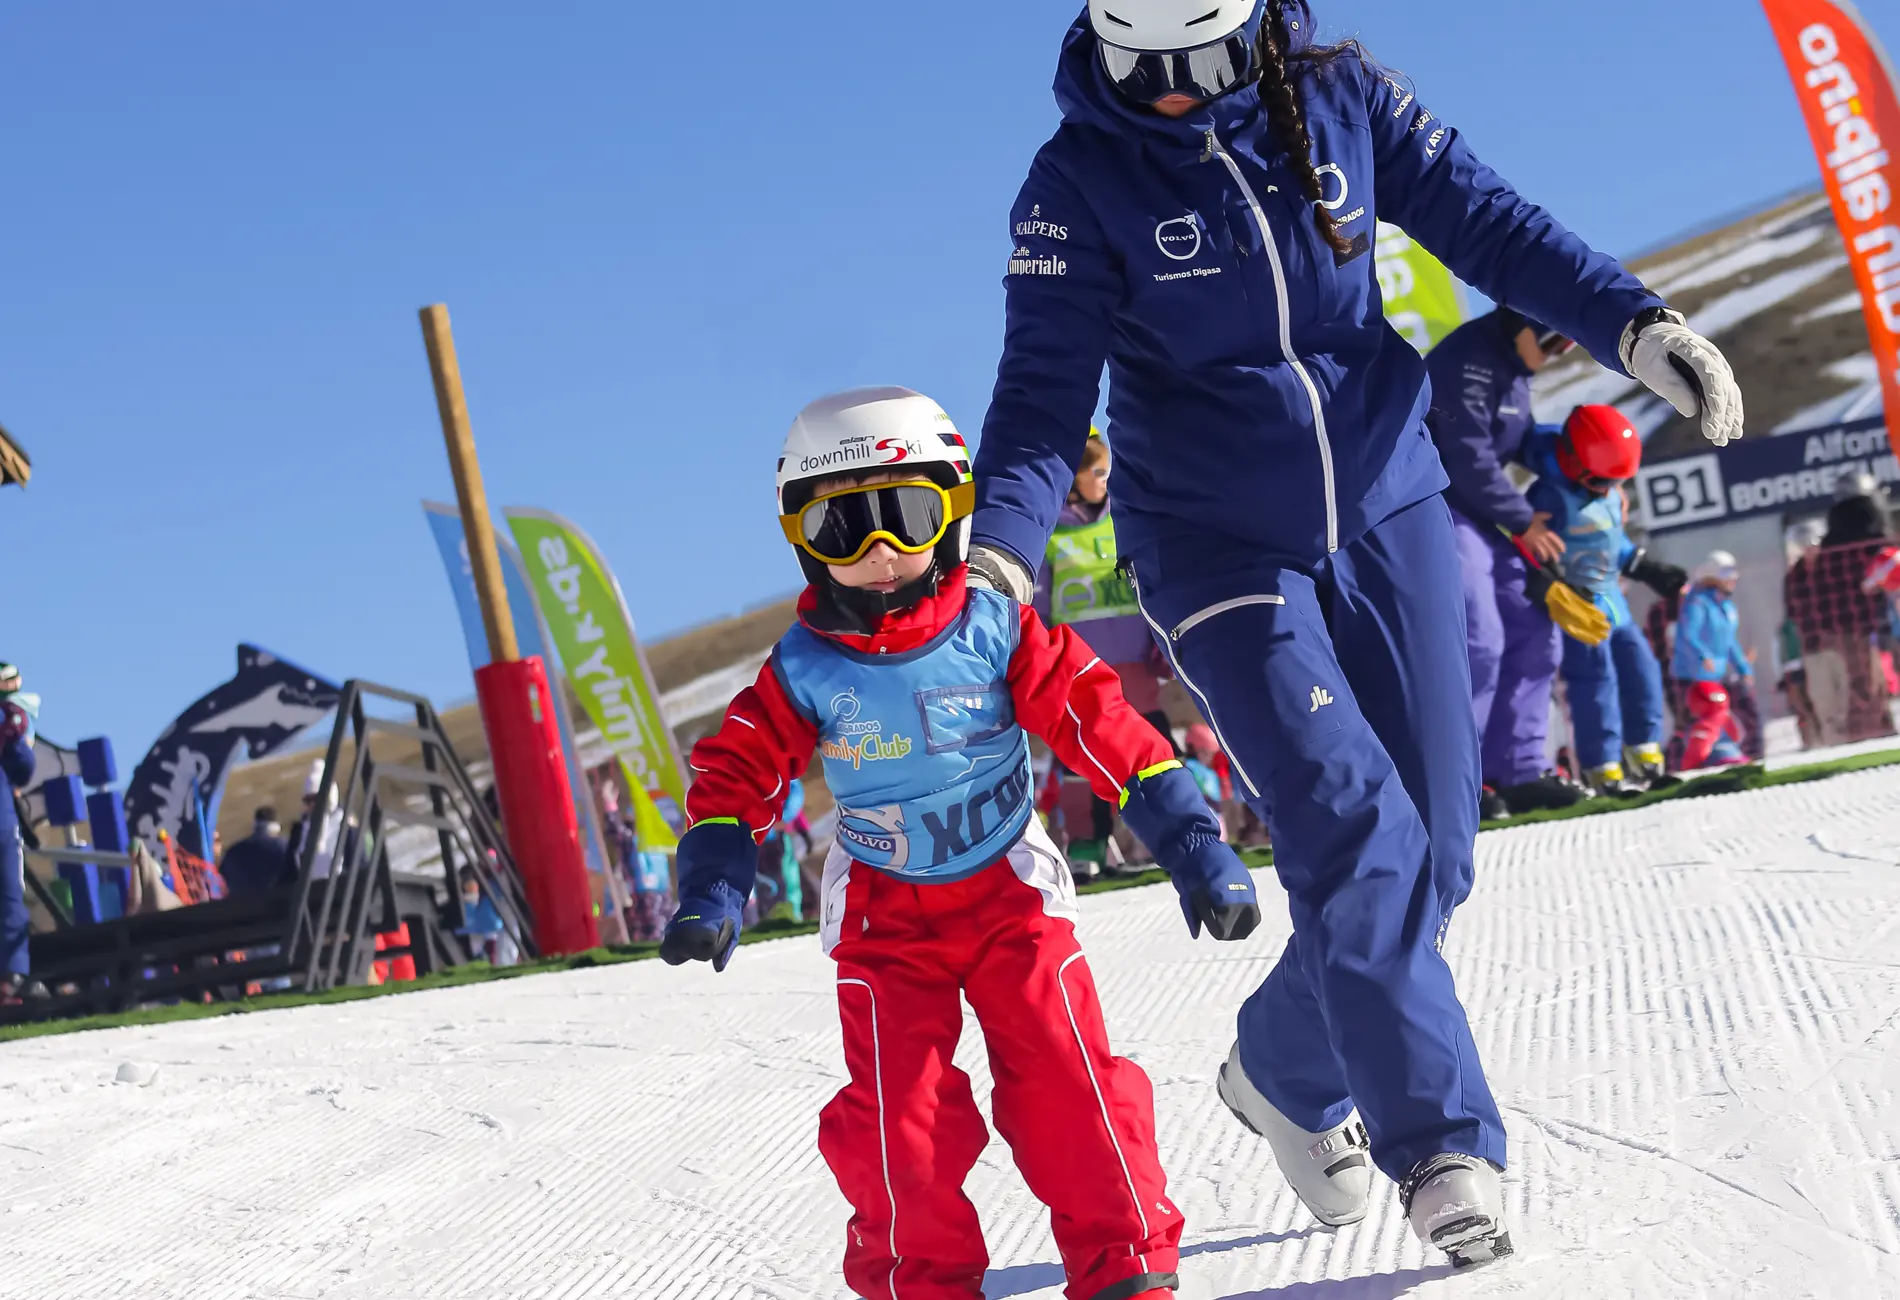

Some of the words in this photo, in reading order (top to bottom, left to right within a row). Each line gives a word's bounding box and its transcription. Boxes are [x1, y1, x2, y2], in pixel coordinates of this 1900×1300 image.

[1014, 220, 1068, 241] SCALPERS
[1160, 233, 1195, 243] VOLVO
[1153, 272, 1192, 282] Turismos
[1192, 266, 1222, 277] Digasa
[839, 435, 875, 446] elan
[800, 442, 870, 473] downhill
[875, 437, 923, 465] Ski
[1646, 467, 1718, 518] B1
